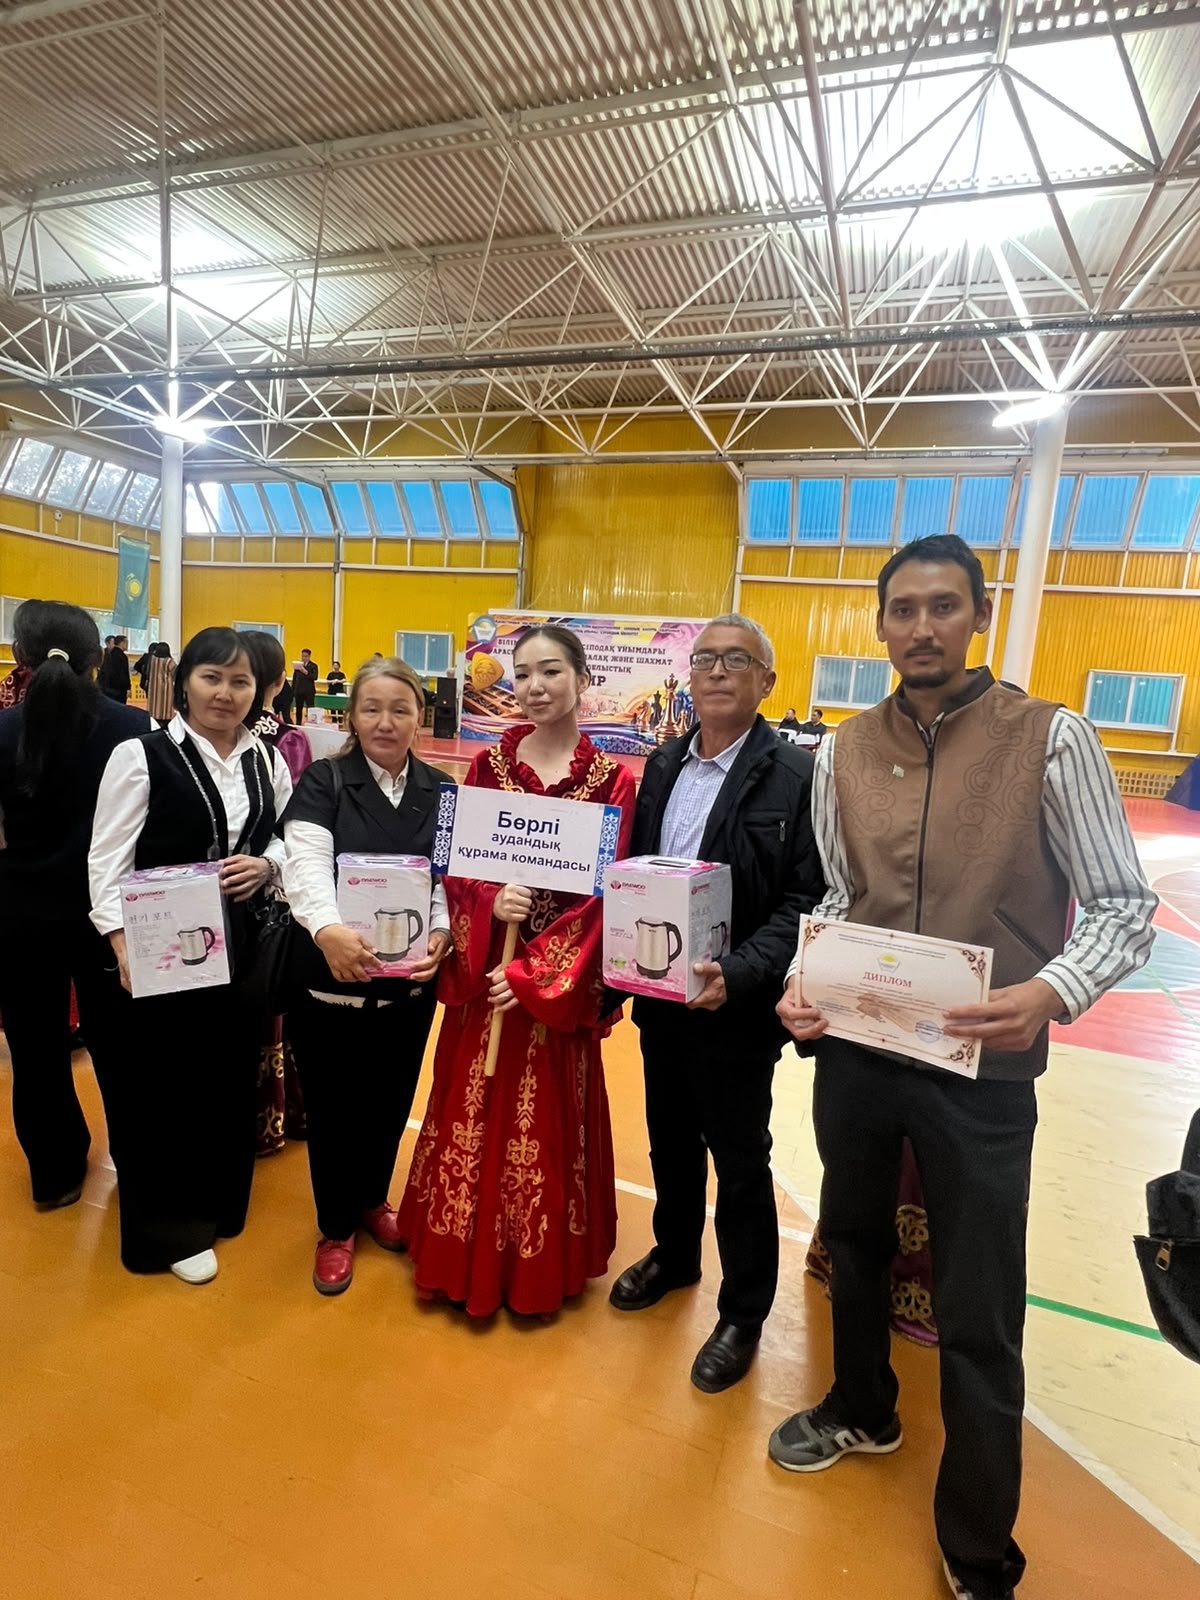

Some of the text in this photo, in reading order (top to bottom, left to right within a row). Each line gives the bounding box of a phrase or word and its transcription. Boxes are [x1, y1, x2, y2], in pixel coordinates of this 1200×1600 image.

[636, 657, 673, 666] ШАХМАТ
[497, 810, 560, 836] Бөрлі
[491, 832, 561, 852] аудандық
[458, 846, 591, 872] құрама командасы
[862, 971, 913, 988] ДИПЛОМ
